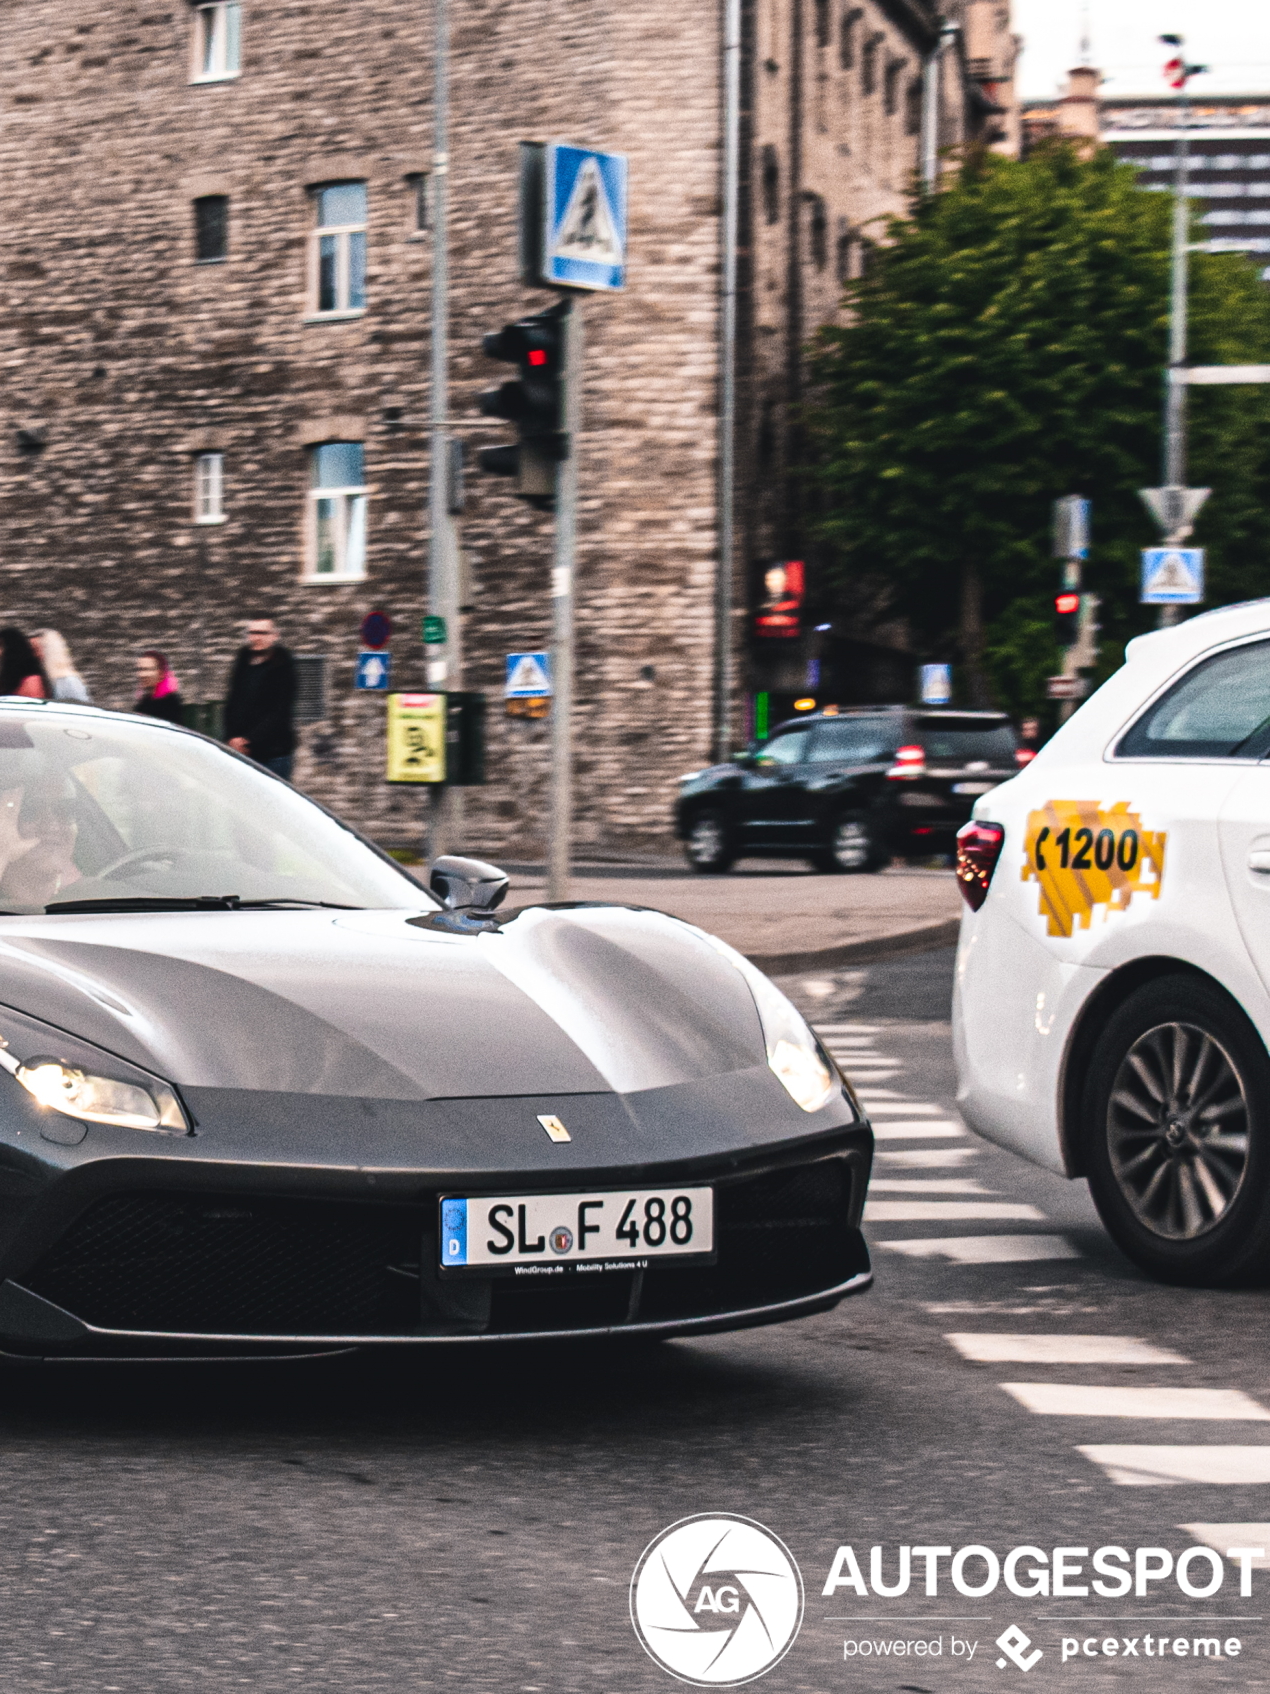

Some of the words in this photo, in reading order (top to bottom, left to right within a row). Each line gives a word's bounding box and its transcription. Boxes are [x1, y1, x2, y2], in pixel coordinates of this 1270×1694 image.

[1055, 827, 1139, 871] 1200
[487, 1203, 546, 1255] SL
[578, 1200, 604, 1250] F
[615, 1196, 693, 1248] 488
[448, 1239, 460, 1255] D
[576, 1263, 603, 1272] Mobility
[604, 1261, 635, 1270] Solutions
